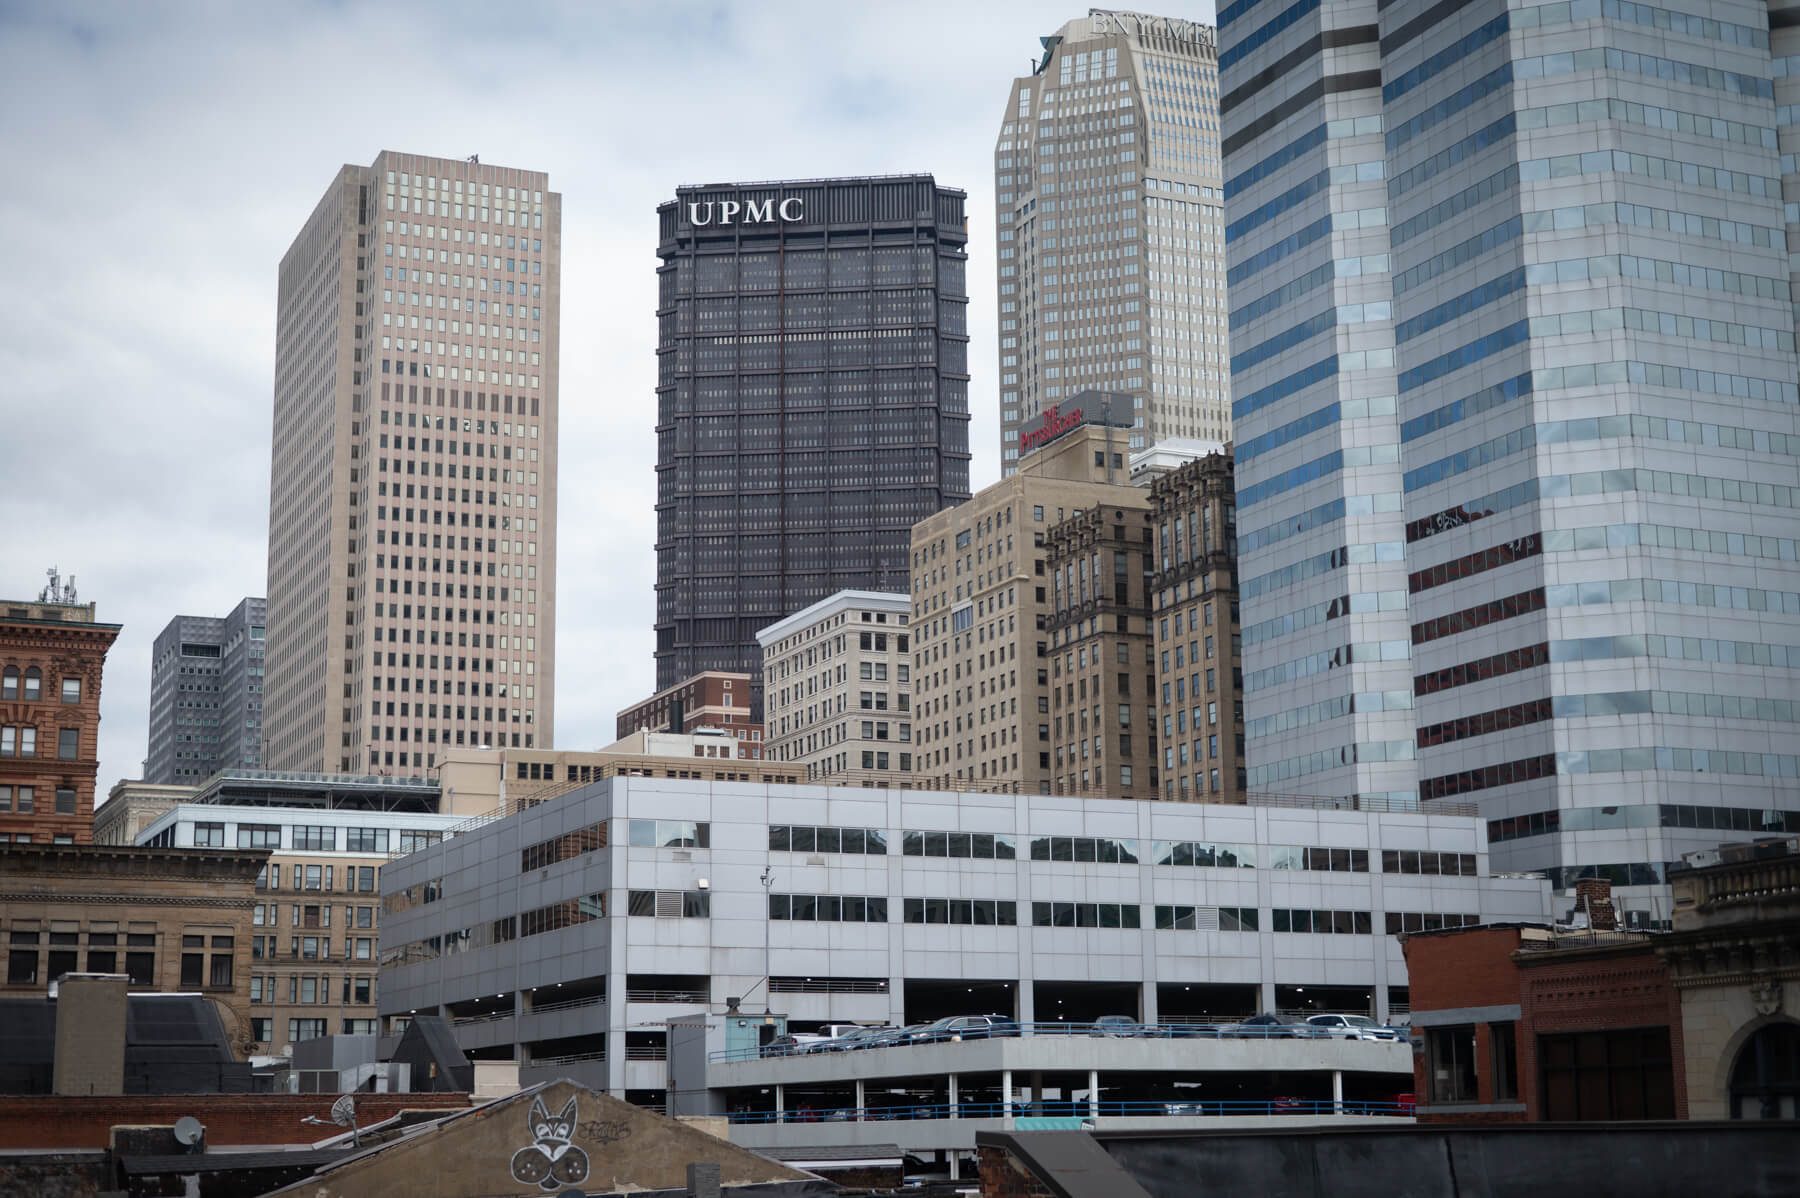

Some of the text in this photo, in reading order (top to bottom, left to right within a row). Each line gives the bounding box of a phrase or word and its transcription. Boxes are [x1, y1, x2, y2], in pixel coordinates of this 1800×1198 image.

[1089, 12, 1153, 36] BNY
[688, 198, 803, 226] UPMC
[1043, 403, 1060, 425] THE
[1020, 408, 1082, 453] PITTSBURGHER
